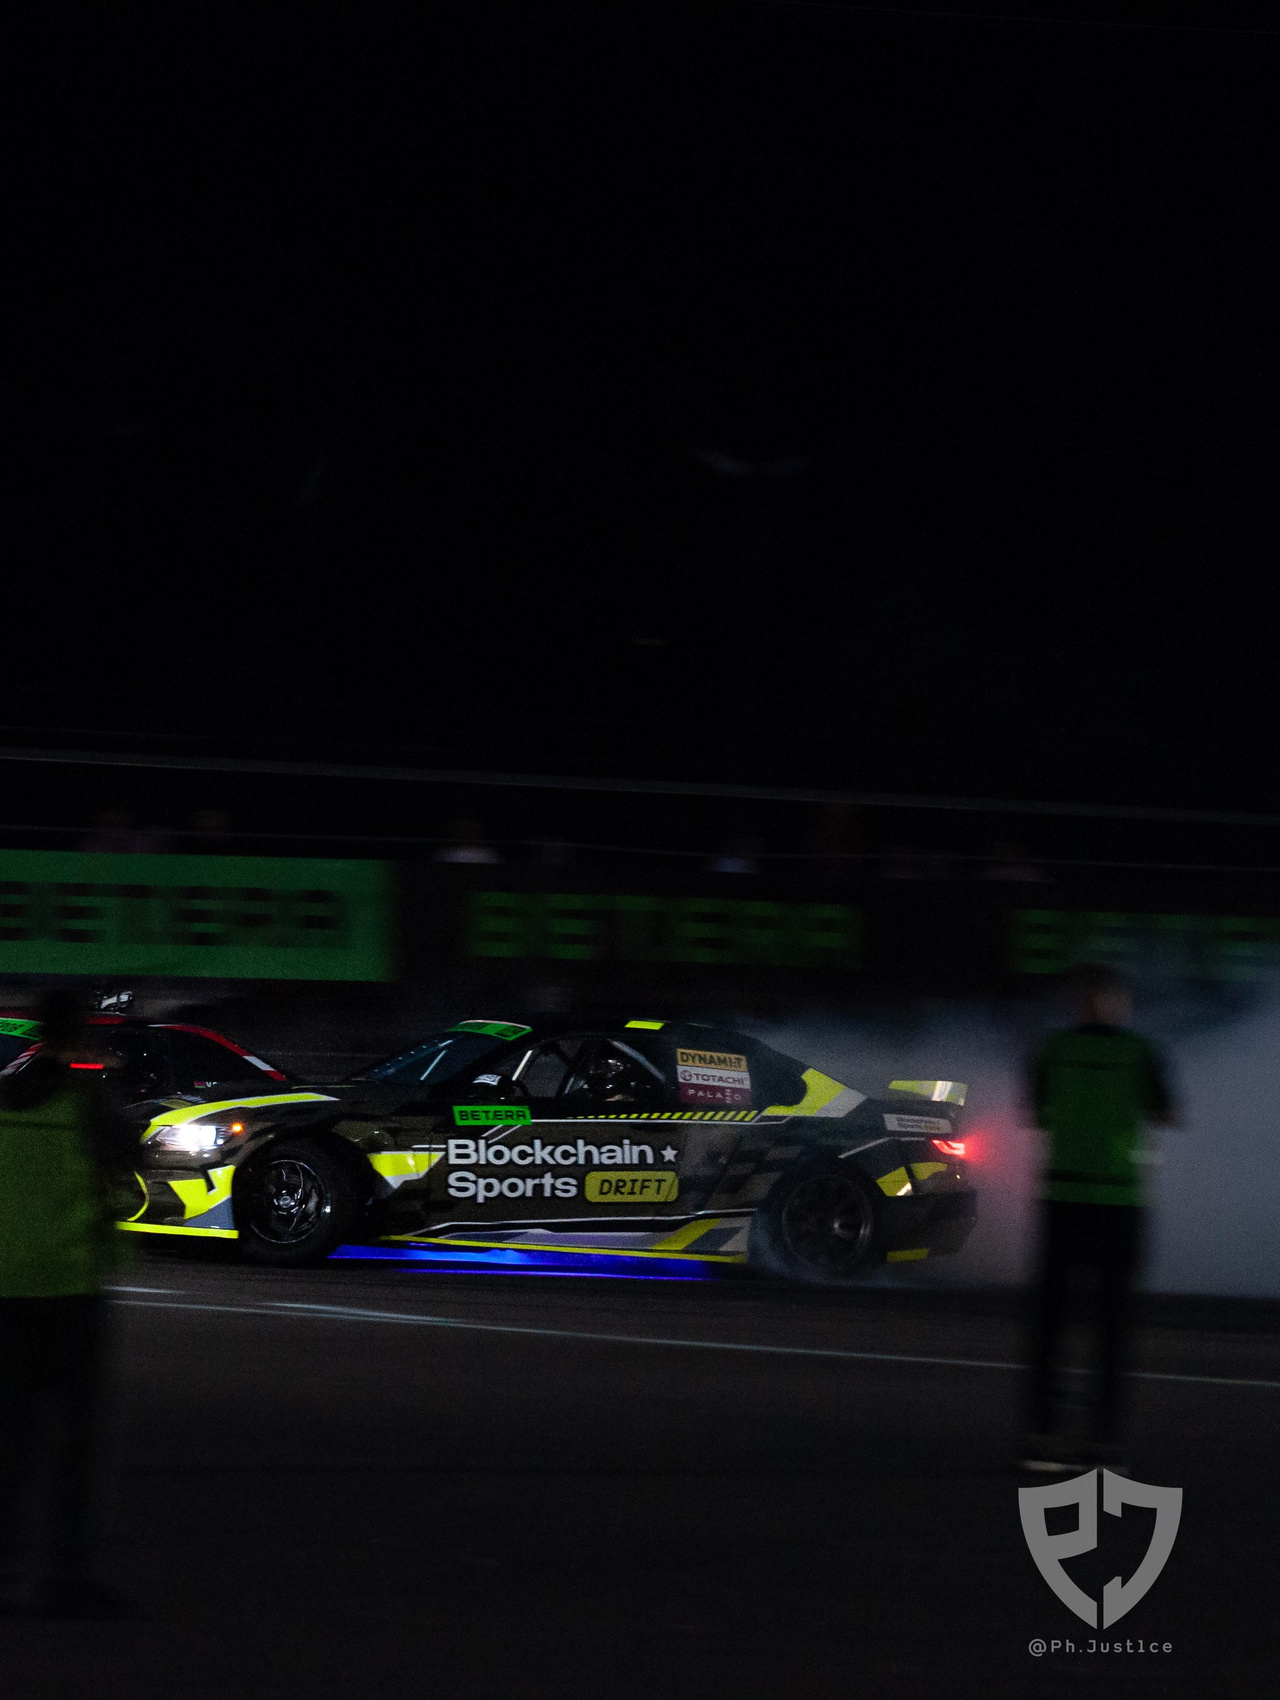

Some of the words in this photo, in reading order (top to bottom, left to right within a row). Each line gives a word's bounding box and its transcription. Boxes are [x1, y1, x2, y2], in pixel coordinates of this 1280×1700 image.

[693, 1072, 746, 1085] TOTACHI
[458, 1110, 527, 1121] BETERA
[447, 1139, 654, 1165] Blockchain
[447, 1171, 578, 1203] Sports
[599, 1178, 667, 1196] DRIFT
